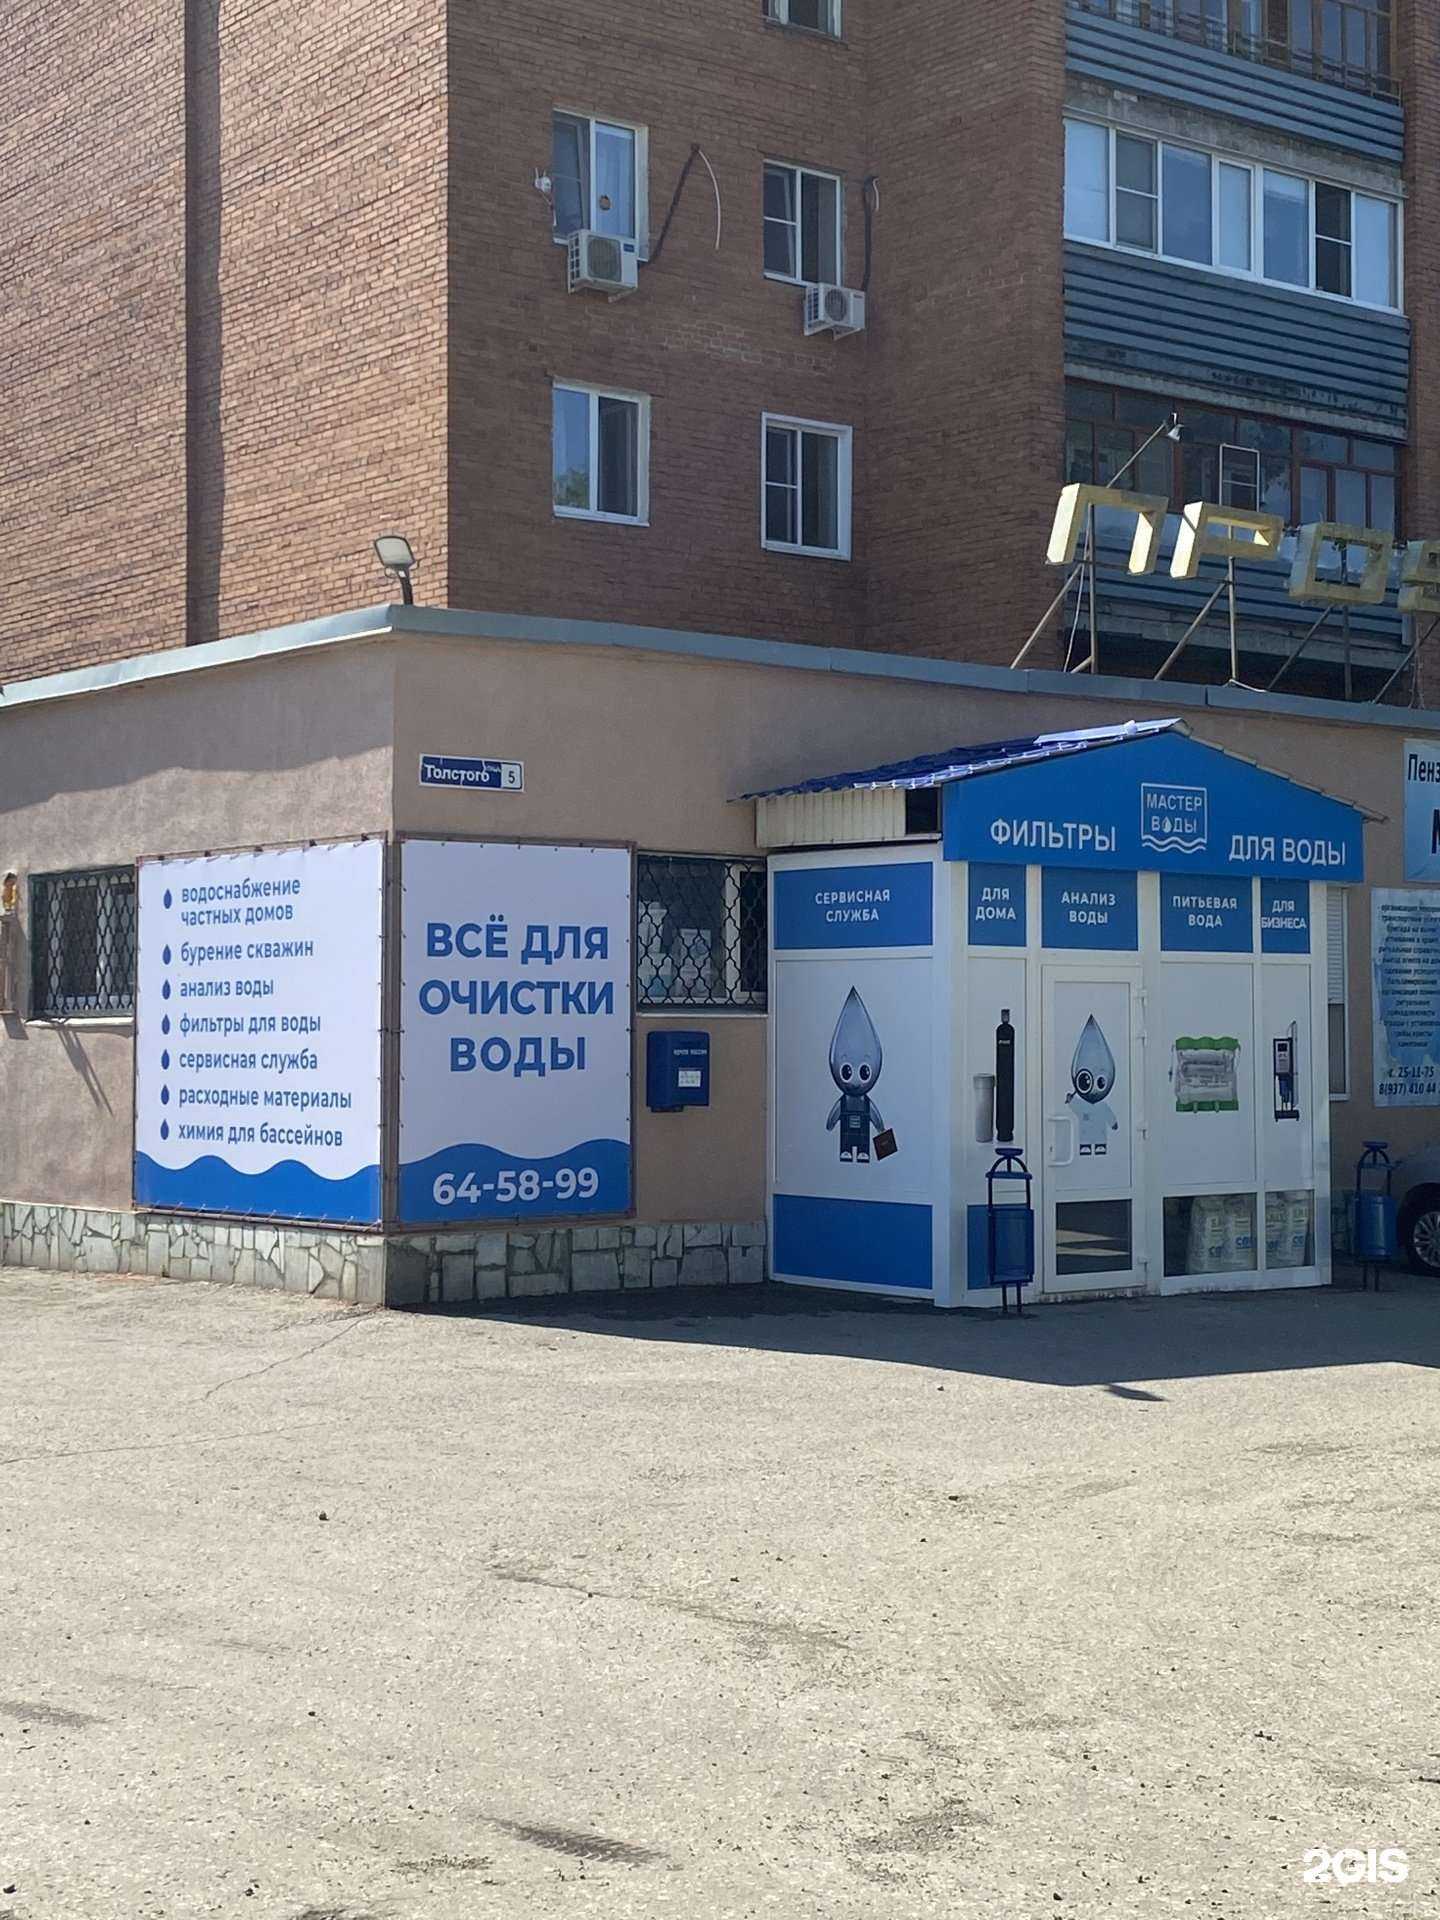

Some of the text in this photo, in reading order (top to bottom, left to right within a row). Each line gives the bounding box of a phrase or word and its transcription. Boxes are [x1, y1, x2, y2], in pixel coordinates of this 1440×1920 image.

[423, 763, 490, 783] Толстого
[508, 770, 516, 784] 5
[1146, 793, 1202, 812] МАСТЕР
[990, 819, 1346, 867] ФИЛЬТРЫ ДЛЯ ВОДЫ
[182, 877, 301, 904] водоснабжение
[815, 888, 890, 905] СЕРВИСНАЯ
[981, 887, 1010, 902] ДЛЯ
[1061, 891, 1116, 906] АНАЛИЗ
[1172, 896, 1237, 910] ПИТЬЕВАЯ
[1271, 900, 1295, 914] ДЛЯ
[181, 903, 293, 926] частных домов
[826, 908, 880, 922] СЛУЖБА
[975, 906, 1017, 922] ДОМА
[1069, 910, 1108, 925] ВОДЫ
[1188, 913, 1223, 928] ВОДА
[1261, 915, 1307, 930] БИЗНЕСА
[427, 914, 609, 966] ВСЁ ДЛЯ
[181, 940, 314, 966] бурение скважин
[180, 978, 274, 998] анализ воды
[418, 979, 614, 1016] ОЧИСТКИ
[179, 1013, 321, 1037] фильтры для воды
[180, 1049, 318, 1073] сервисная служба
[450, 1037, 586, 1077] ВОДЫ
[1398, 1065, 1434, 1078] 25-11-75
[1379, 1082, 1407, 1096] 8(937)
[179, 1087, 352, 1112] расходные материалы
[178, 1123, 342, 1147] химия для бассейнов
[433, 1167, 599, 1205] 64-58-99
